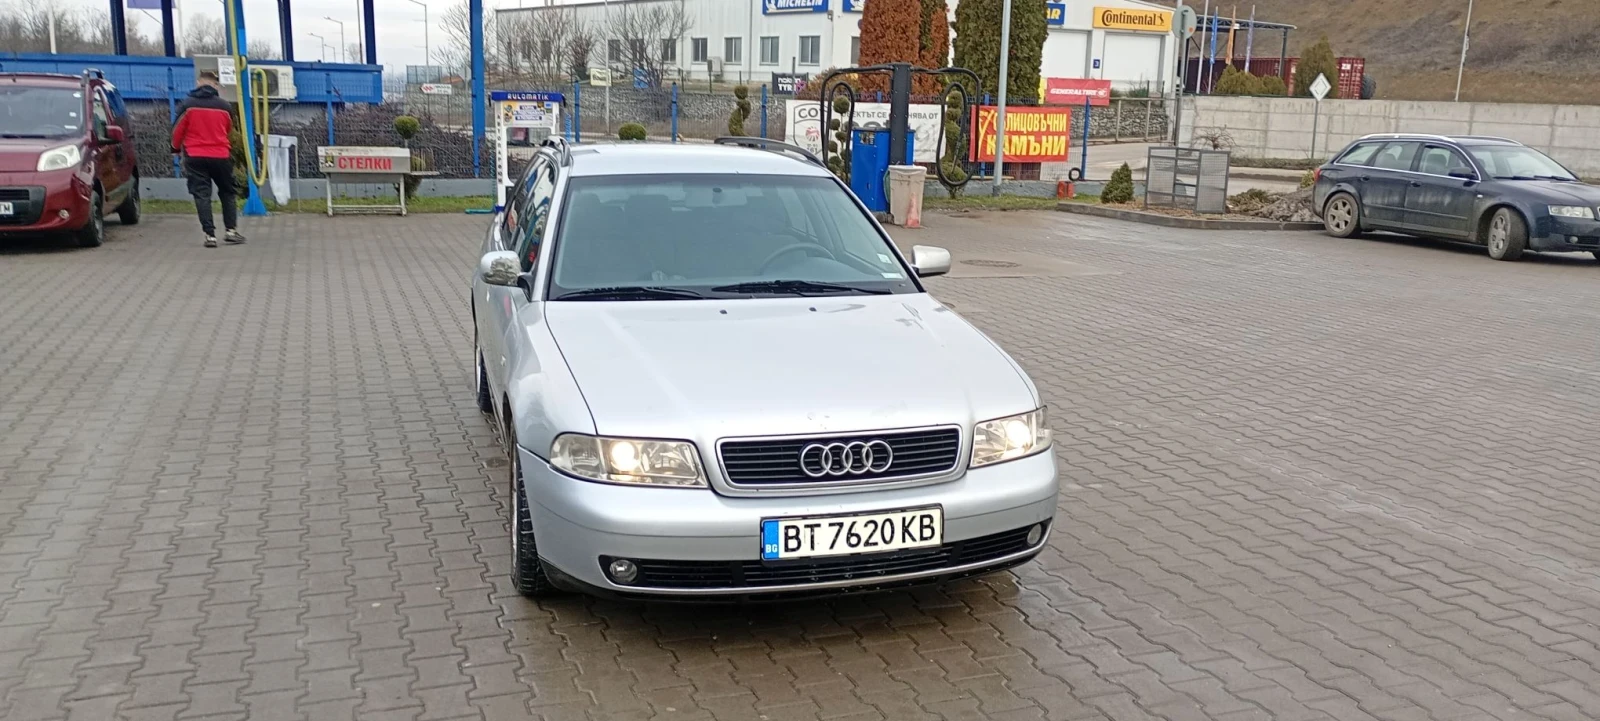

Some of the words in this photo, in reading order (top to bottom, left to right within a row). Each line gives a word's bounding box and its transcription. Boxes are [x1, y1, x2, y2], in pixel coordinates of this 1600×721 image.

[1101, 9, 1157, 27] Continental
[992, 112, 1067, 134] ОЛИЦОВЪЧНИ
[338, 157, 392, 170] СТЕЛКИ
[784, 523, 821, 552] BT
[828, 518, 895, 550] 7620
[901, 514, 935, 543] KB
[765, 544, 778, 553] BG
